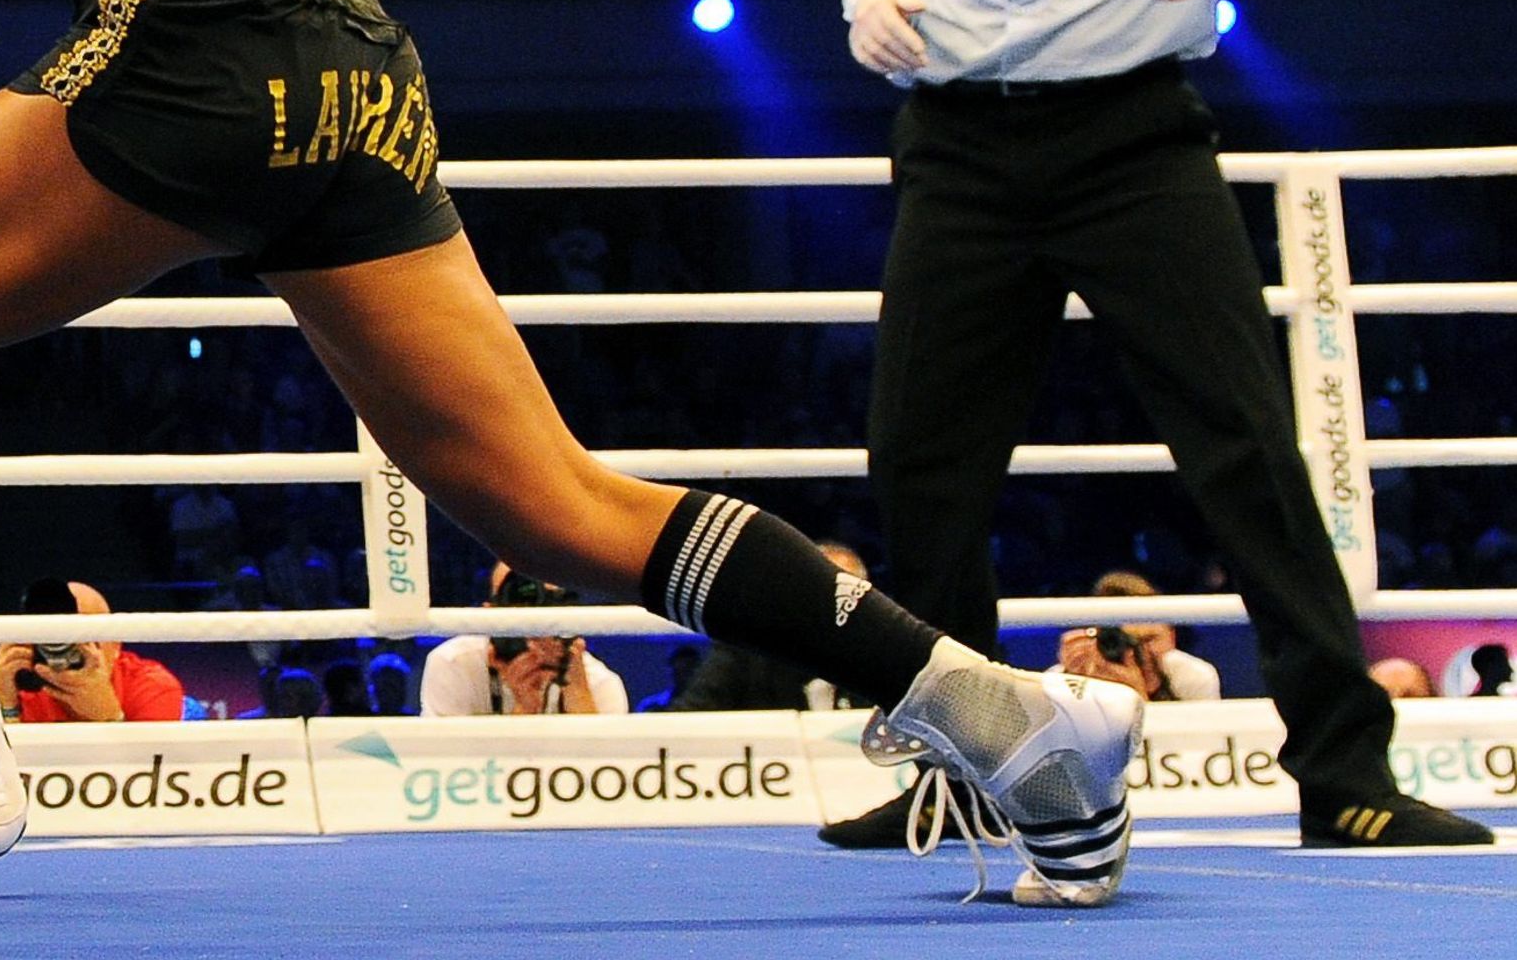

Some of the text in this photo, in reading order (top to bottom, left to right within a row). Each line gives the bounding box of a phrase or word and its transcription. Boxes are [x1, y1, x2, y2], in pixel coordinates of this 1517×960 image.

[1302, 188, 1345, 361] getgoods.de
[378, 458, 415, 594] getgood
[1317, 373, 1361, 552] getgoods.de
[403, 746, 793, 822] getgoods.de
